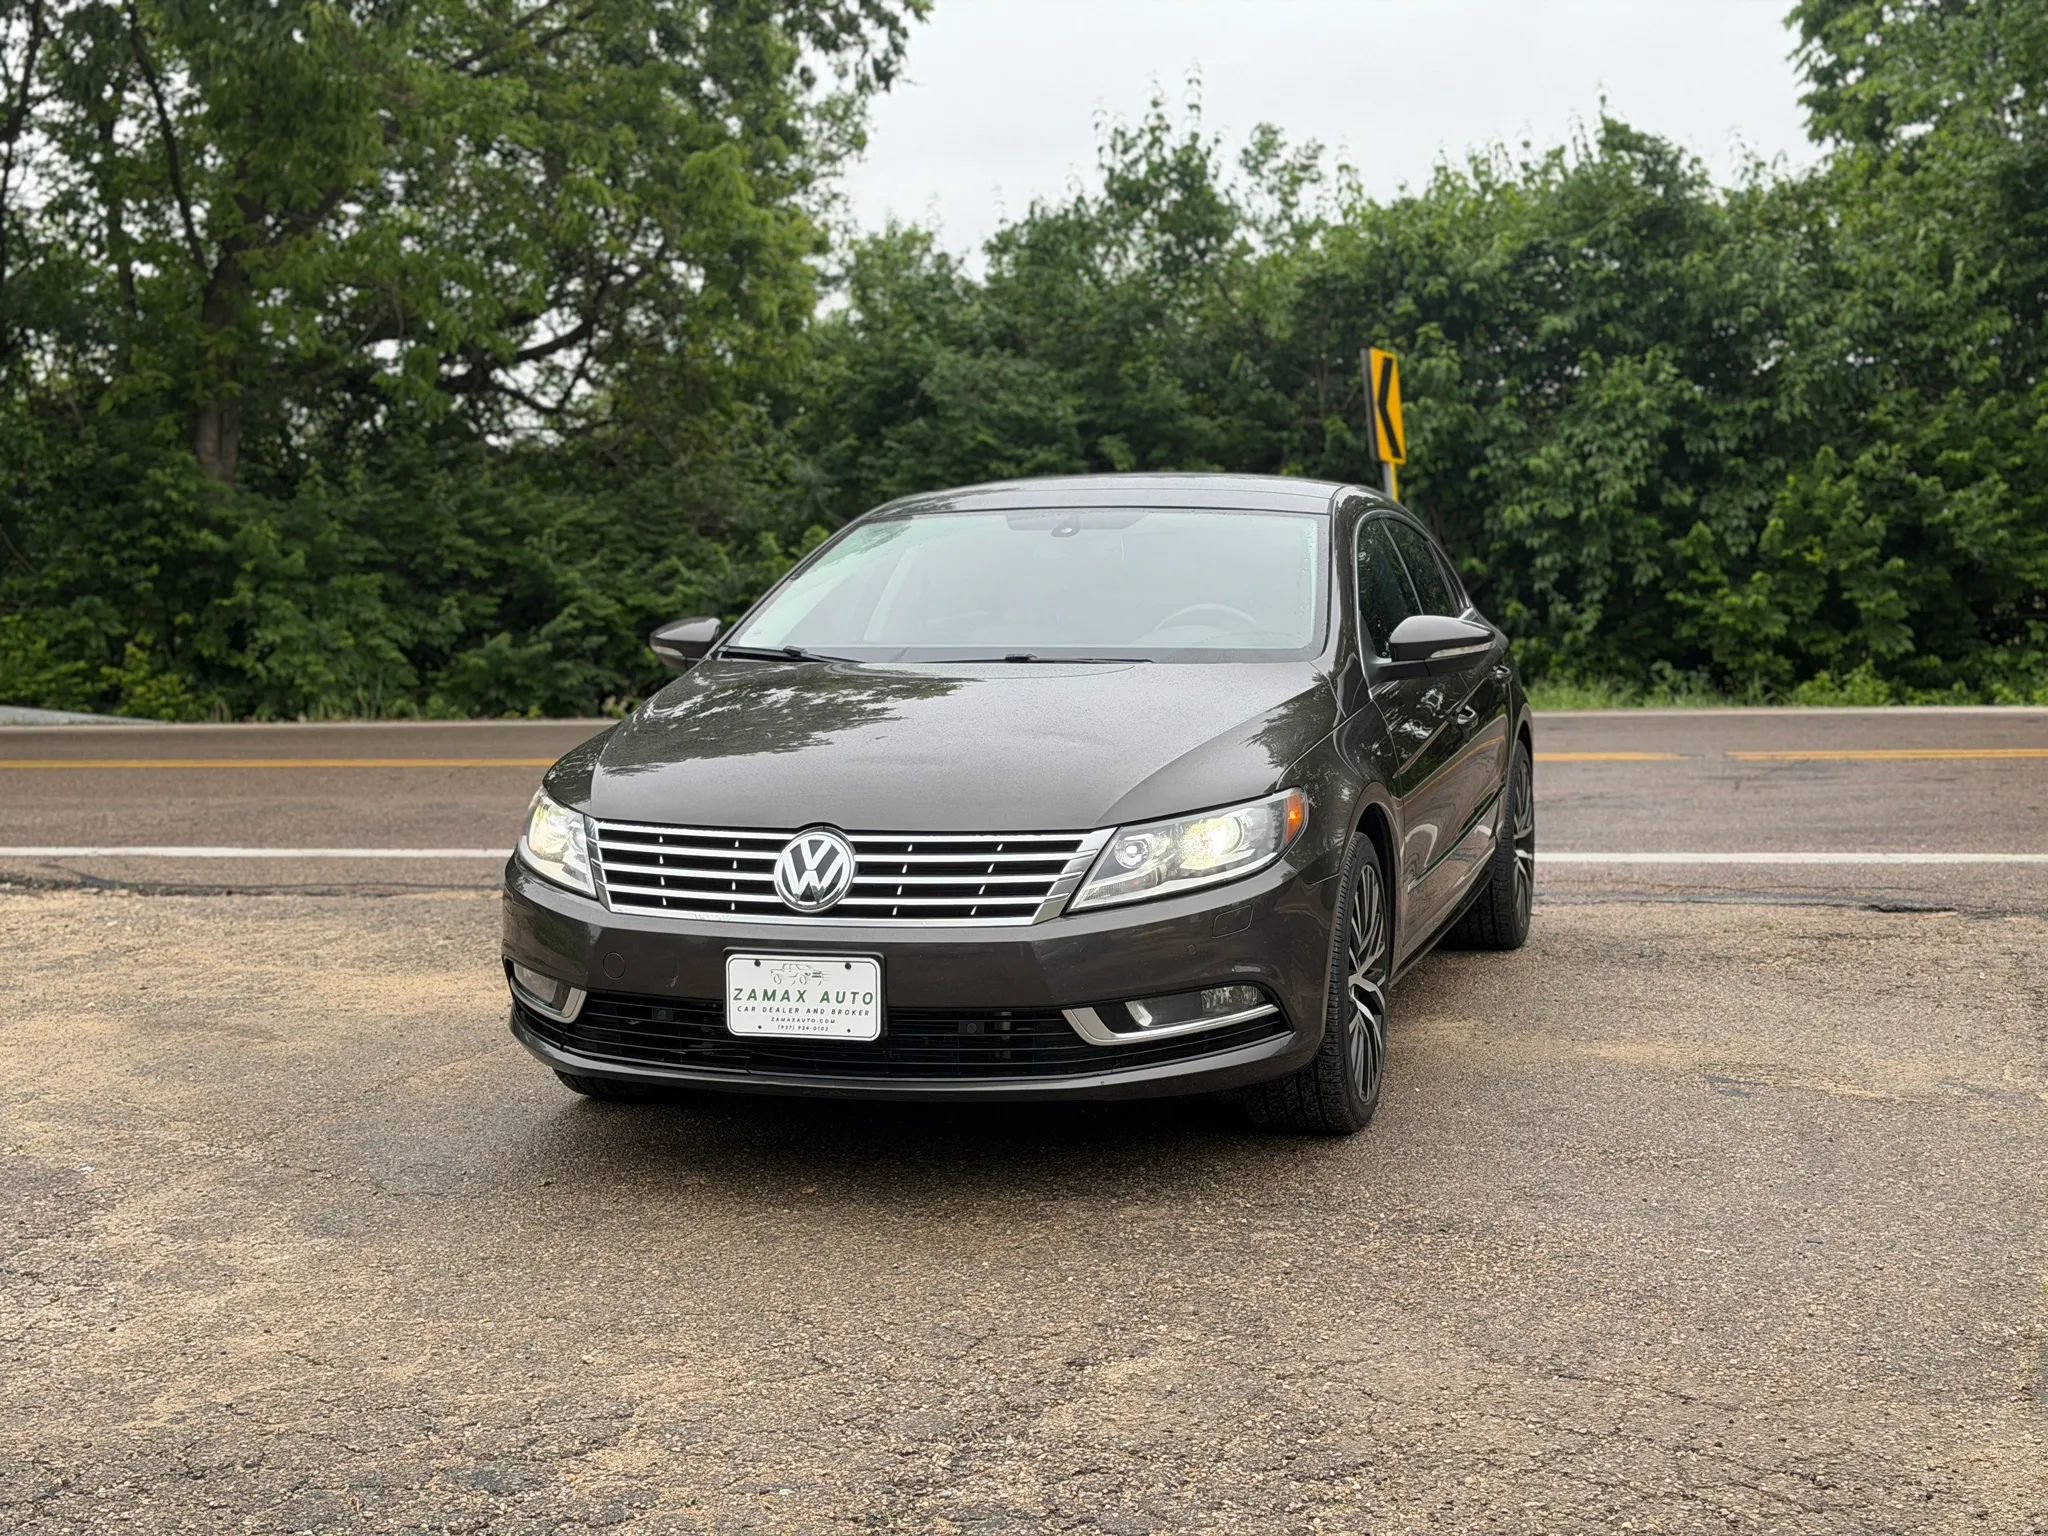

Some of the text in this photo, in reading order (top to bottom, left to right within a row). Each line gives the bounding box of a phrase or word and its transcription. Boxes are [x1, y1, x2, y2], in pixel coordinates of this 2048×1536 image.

[778, 829, 849, 906] VW
[732, 988, 874, 1005] ZAMAX AUTO
